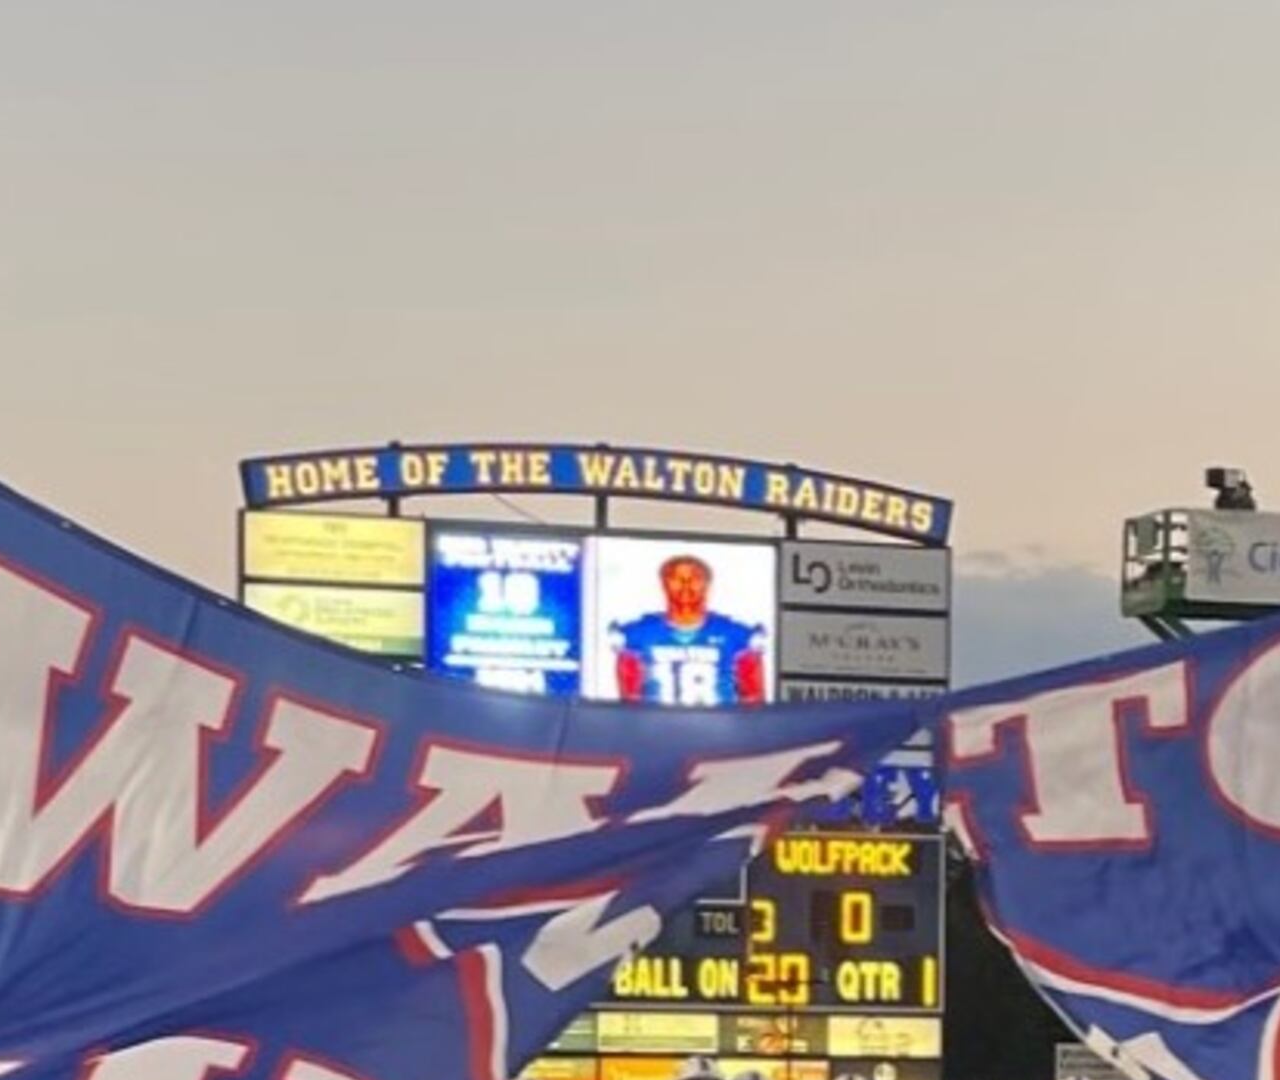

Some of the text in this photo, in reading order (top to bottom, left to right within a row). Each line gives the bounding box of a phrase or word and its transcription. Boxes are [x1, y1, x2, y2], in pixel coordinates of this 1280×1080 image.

[266, 452, 934, 533] HOME OF THE WALTON RAIDERS
[775, 839, 912, 876] WOLFPACK
[699, 911, 739, 934] TOL
[840, 892, 873, 944] 0
[614, 956, 689, 998] BALL
[698, 958, 739, 998] ON
[835, 960, 902, 1001] QTR
